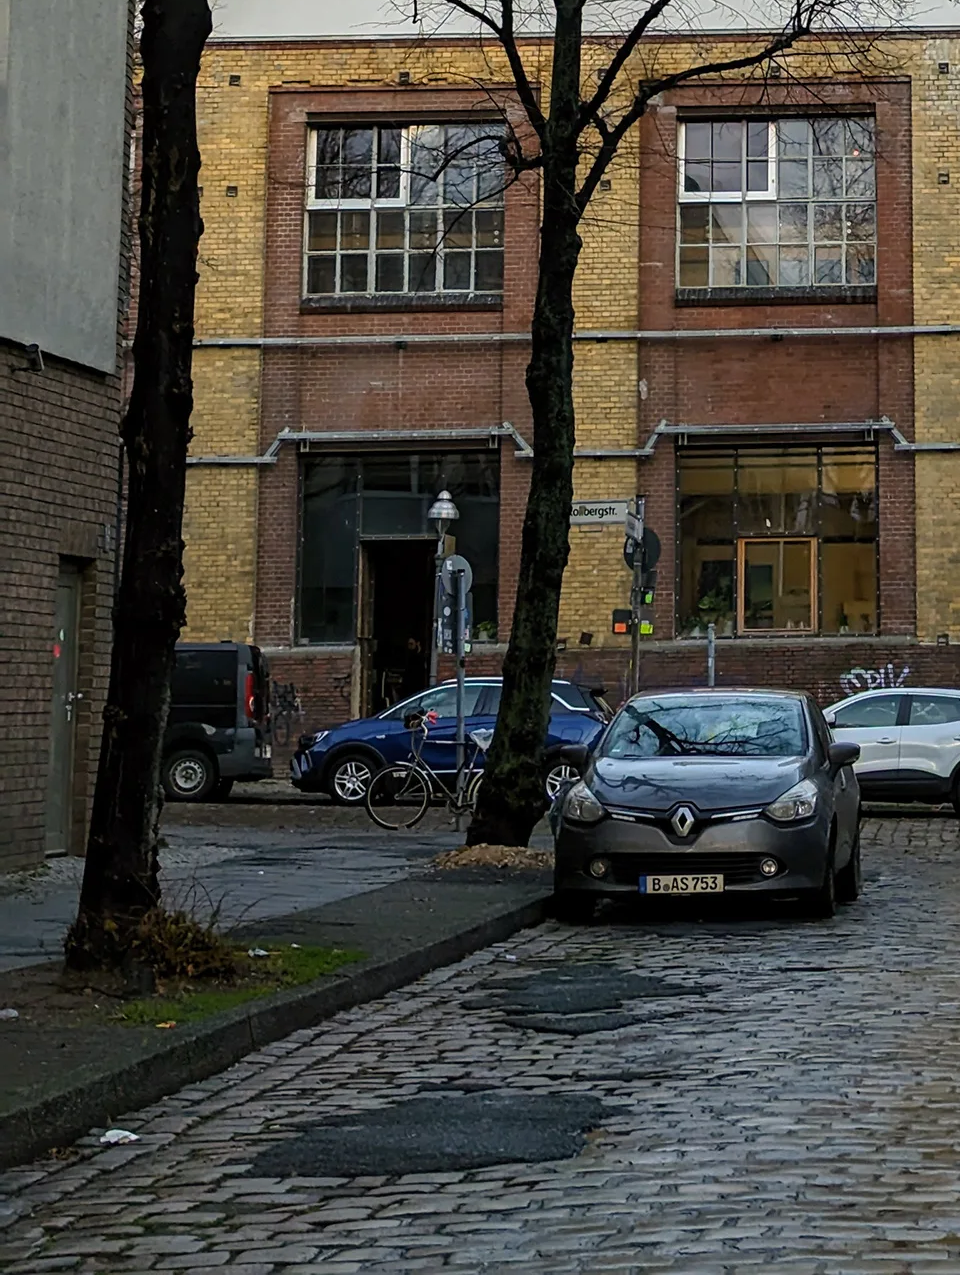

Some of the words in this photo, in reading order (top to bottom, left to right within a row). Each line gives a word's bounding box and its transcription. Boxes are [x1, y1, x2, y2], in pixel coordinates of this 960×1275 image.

[652, 878, 661, 892] B
[671, 877, 689, 891] AS
[691, 876, 718, 891] 753
